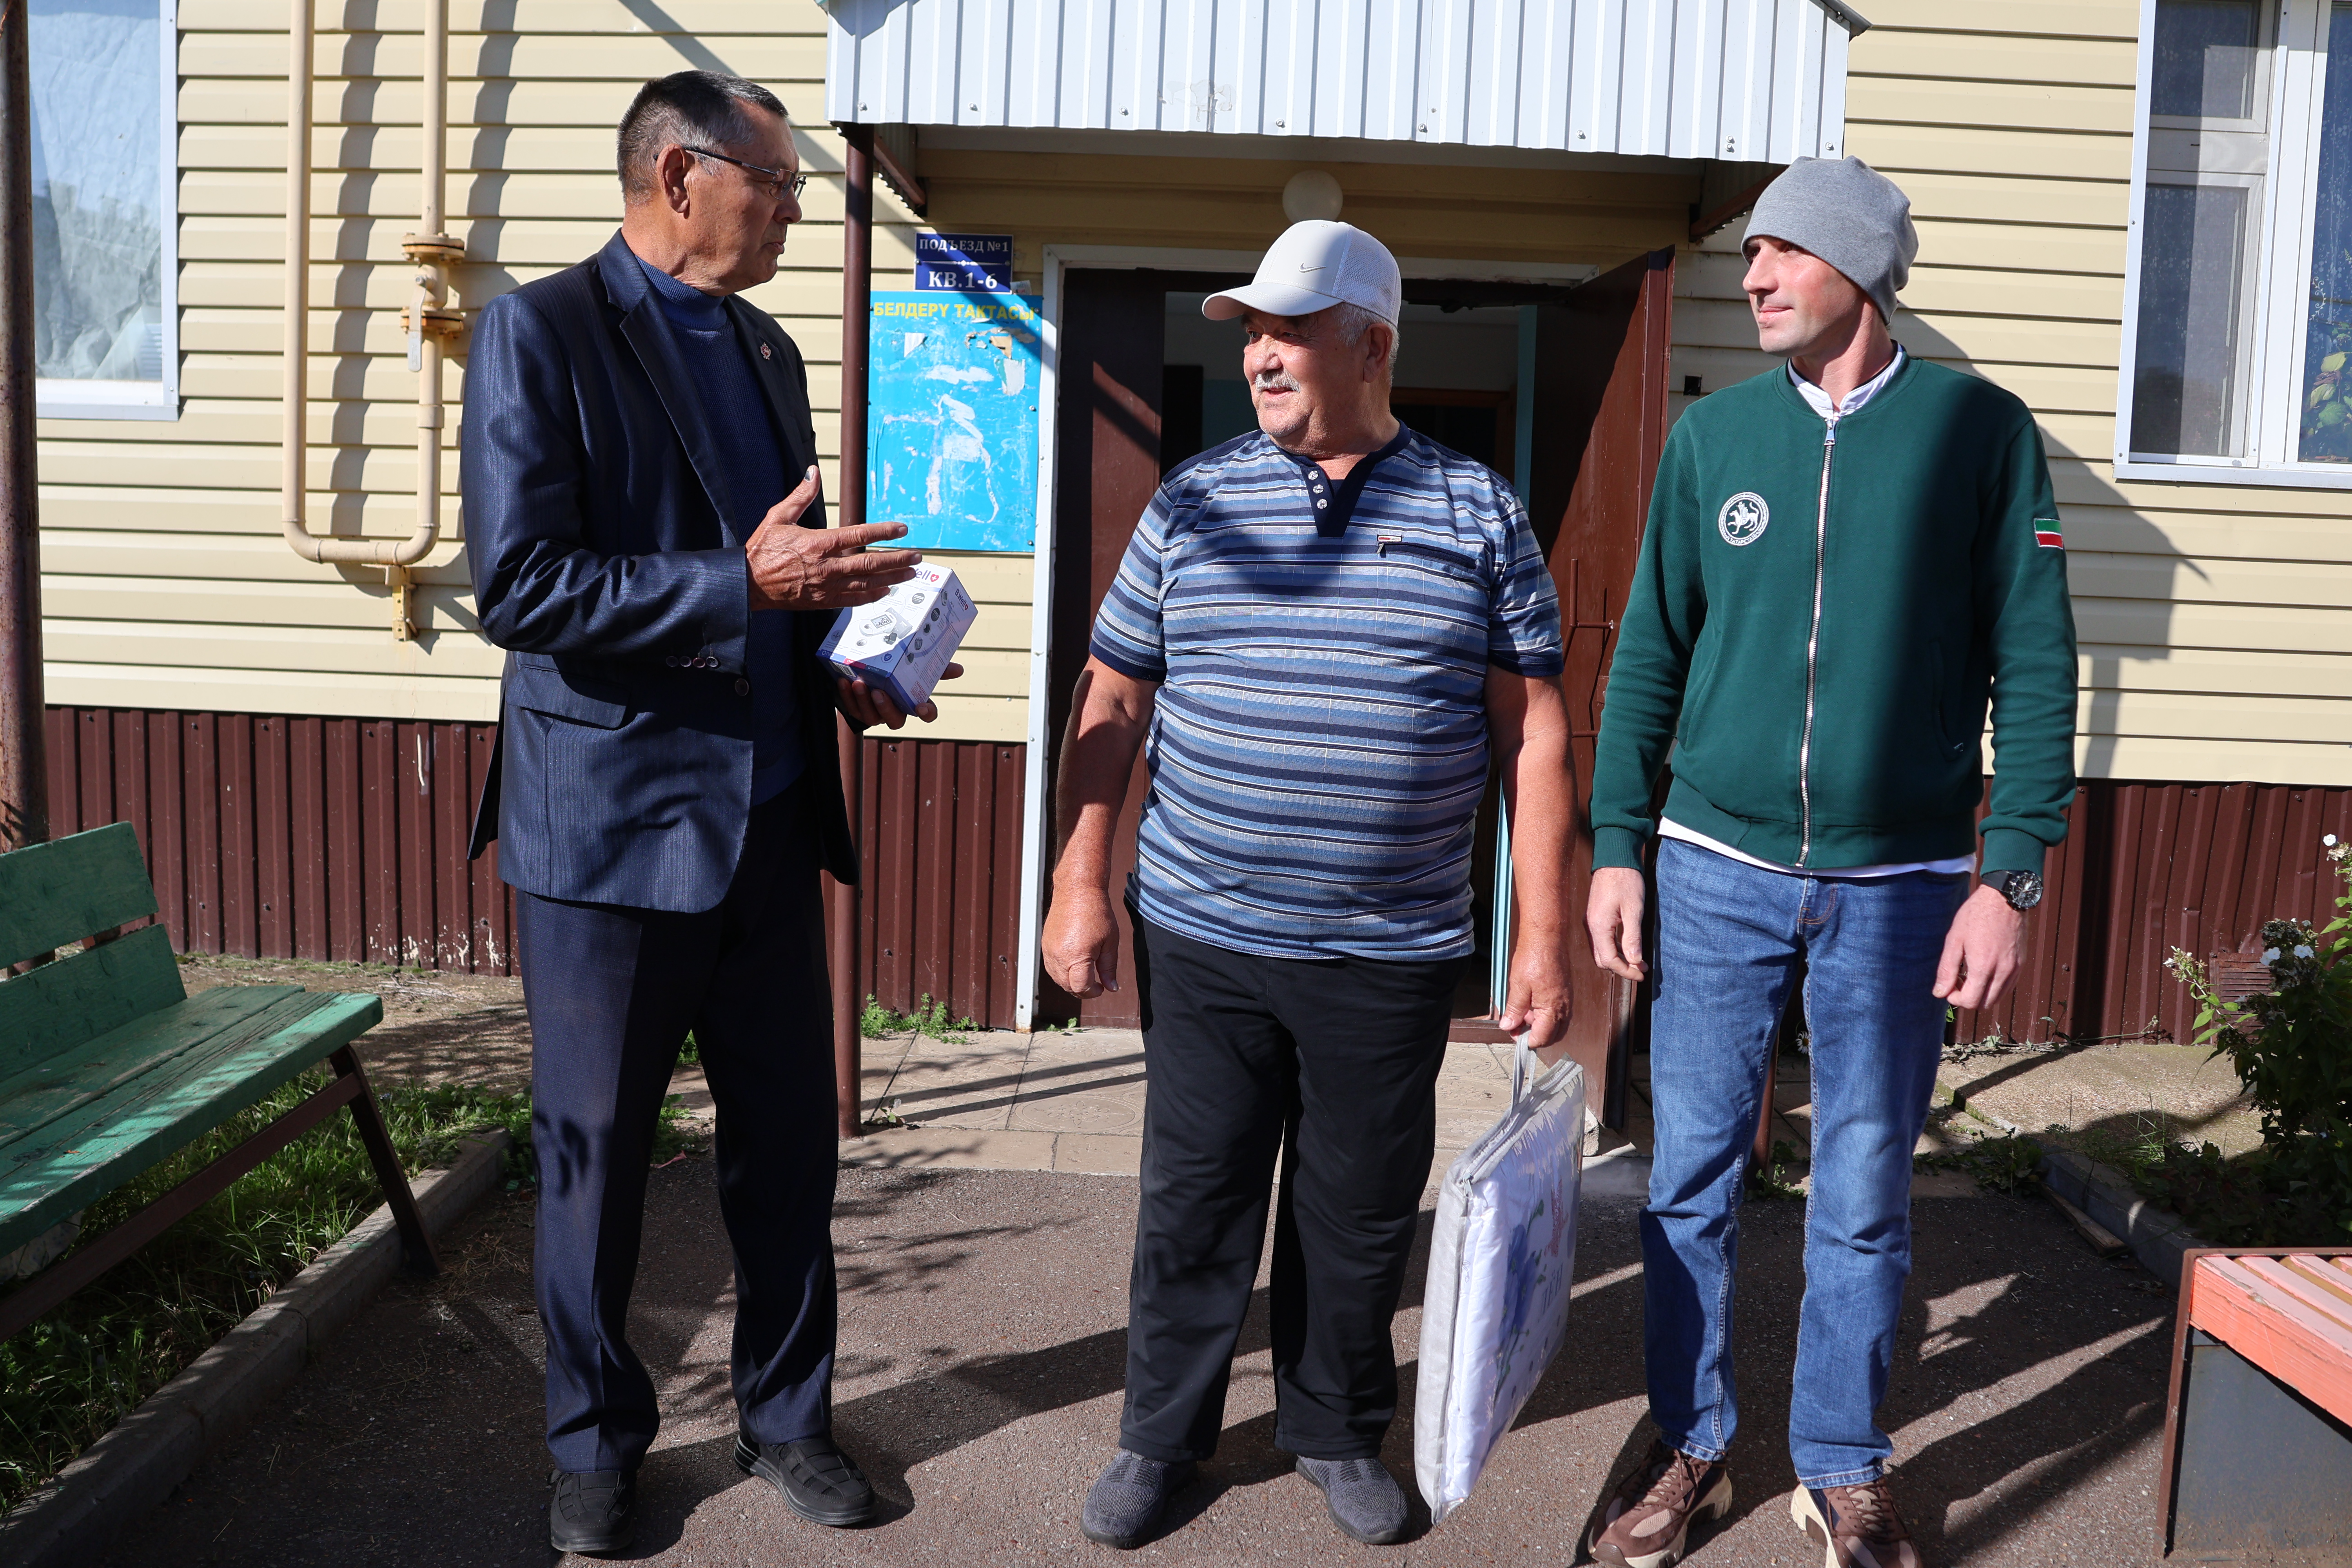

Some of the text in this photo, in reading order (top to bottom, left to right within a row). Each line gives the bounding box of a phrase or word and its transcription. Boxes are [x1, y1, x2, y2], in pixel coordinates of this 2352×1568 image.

[919, 239, 1009, 253] ПОДЪЕЗД №1
[928, 271, 998, 289] КВ.1-6
[954, 304, 1034, 320] ТАКТАСЫ
[955, 588, 967, 608] B.Well
